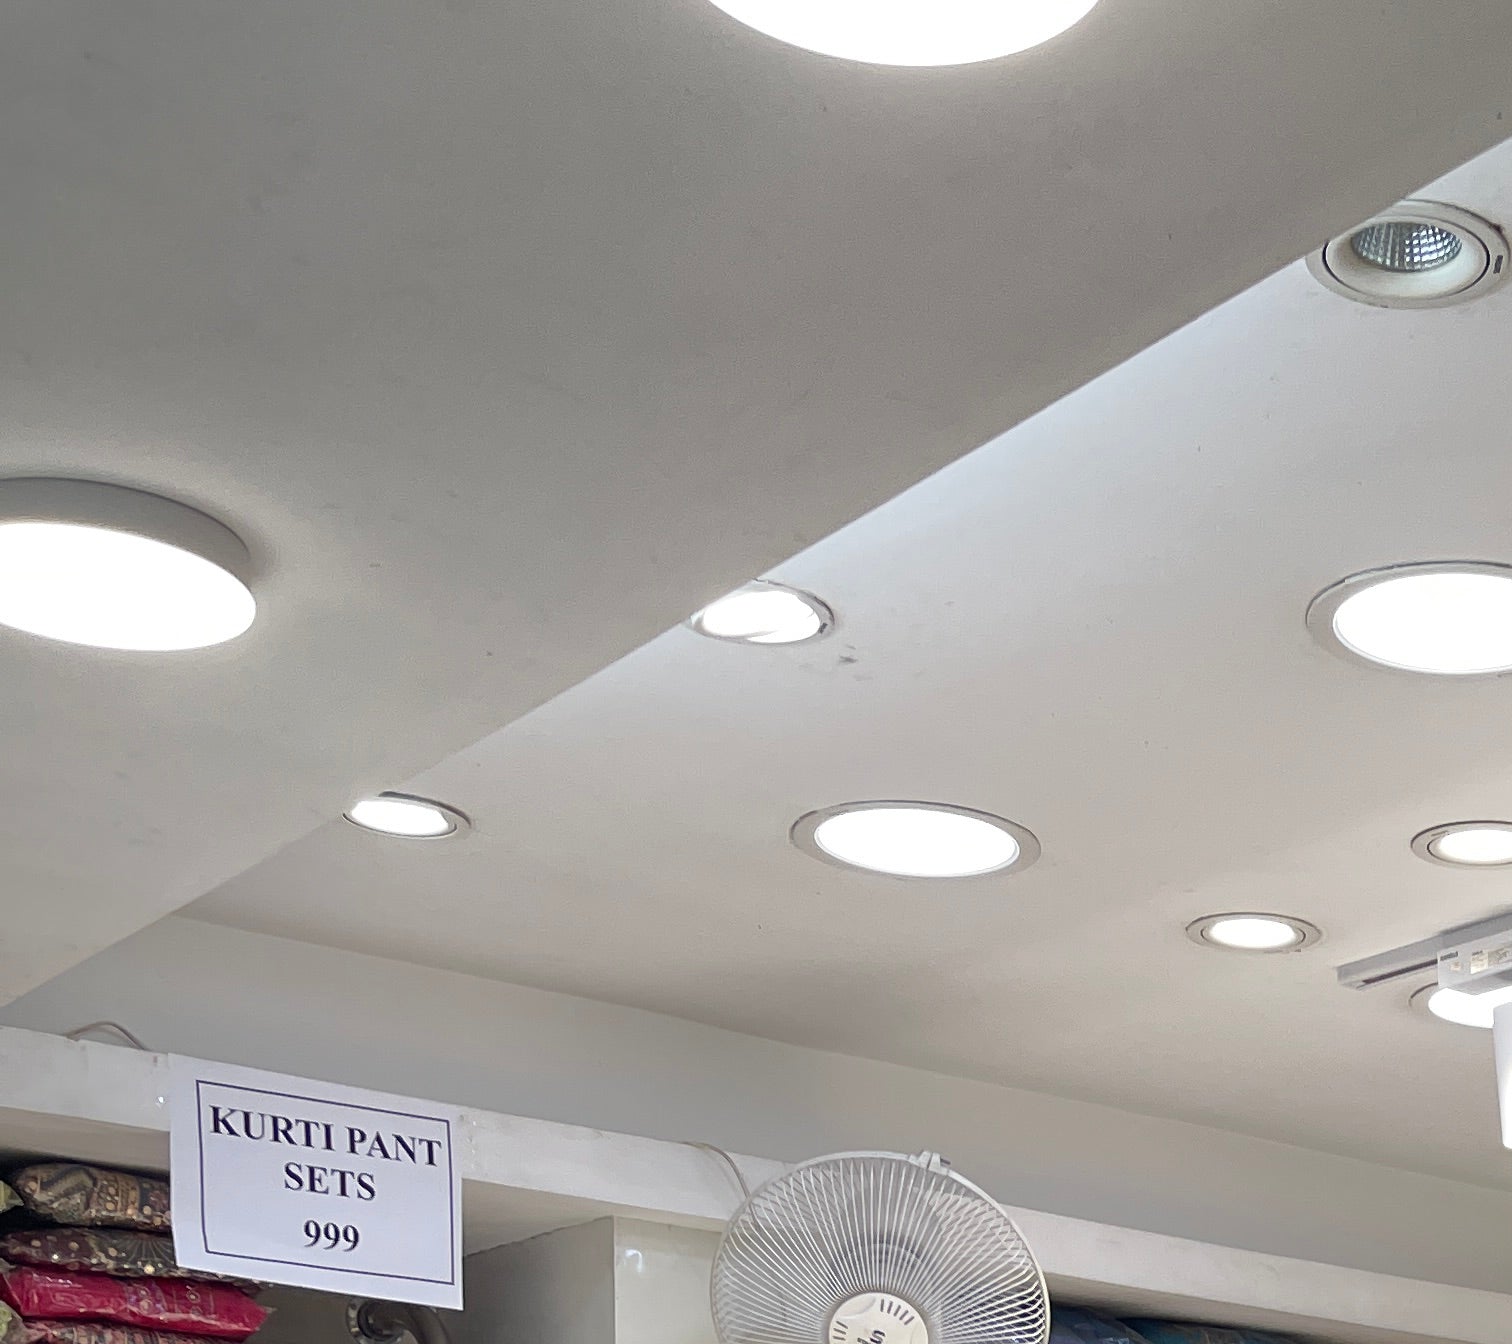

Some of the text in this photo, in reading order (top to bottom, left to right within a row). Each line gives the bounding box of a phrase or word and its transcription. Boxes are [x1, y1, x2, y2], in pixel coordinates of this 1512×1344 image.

[208, 1104, 443, 1167] KURTI PANT
[284, 1162, 377, 1201] SETS
[303, 1219, 360, 1252] 999
